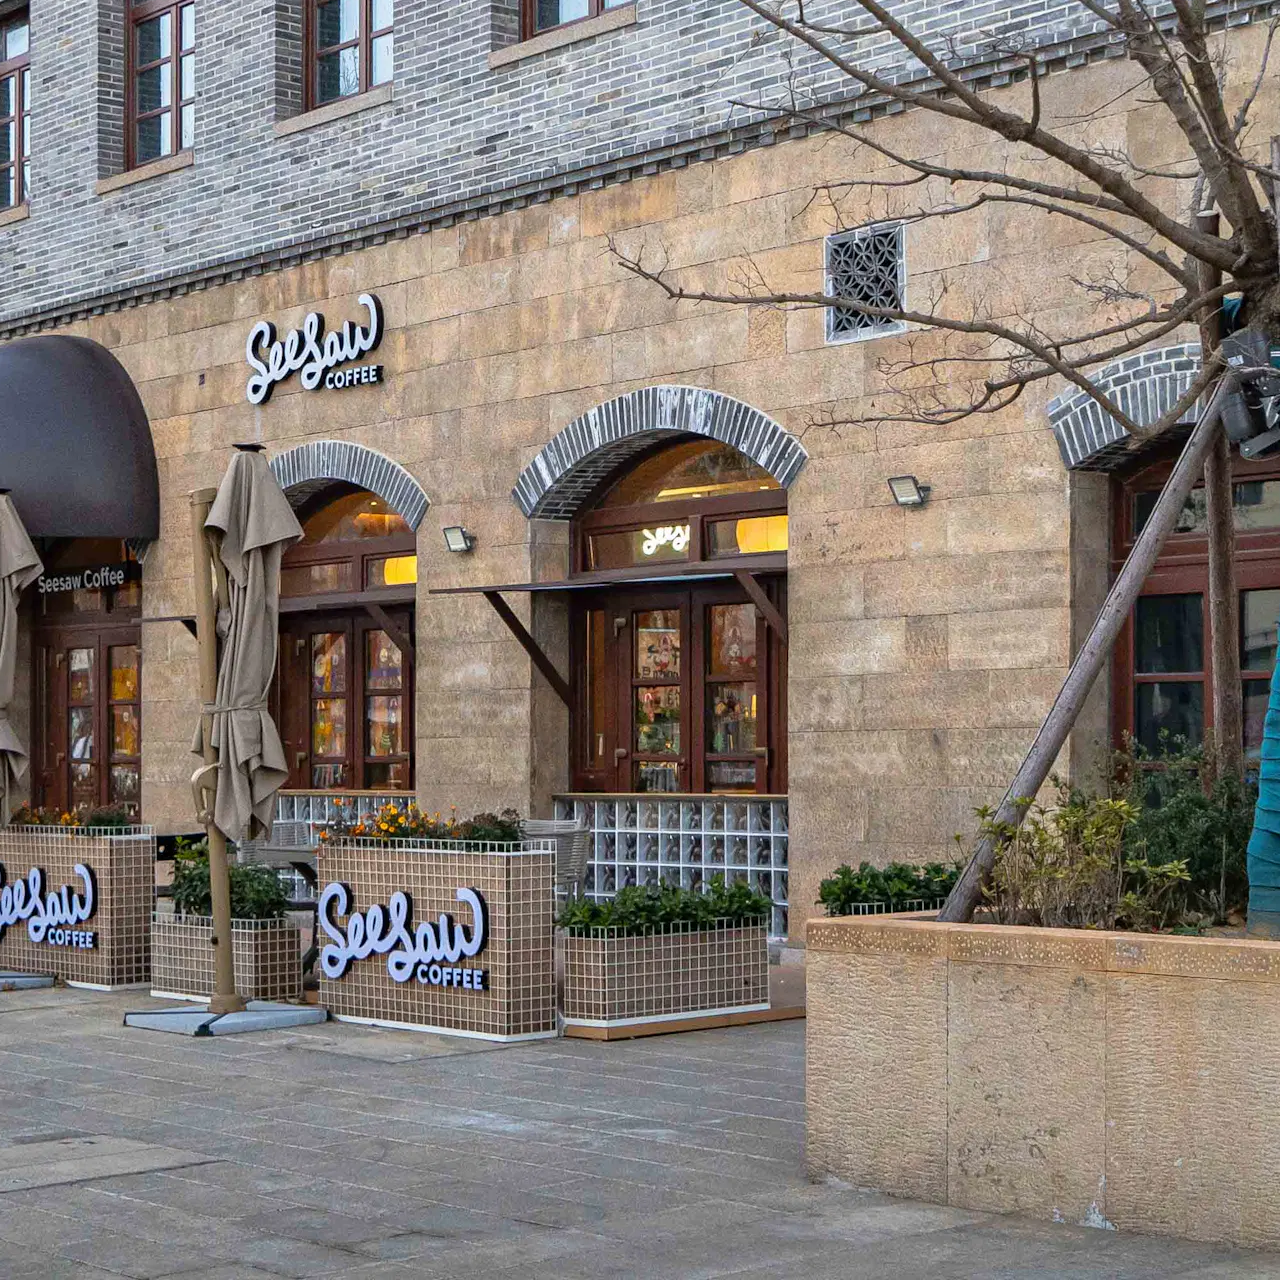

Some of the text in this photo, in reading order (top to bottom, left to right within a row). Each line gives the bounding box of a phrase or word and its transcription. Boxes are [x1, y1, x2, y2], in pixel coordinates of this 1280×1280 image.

[325, 365, 383, 389] COFFEE
[38, 566, 124, 593] Seesaw Coffee
[47, 927, 96, 949] COFFEE
[416, 964, 488, 990] COFFEE
